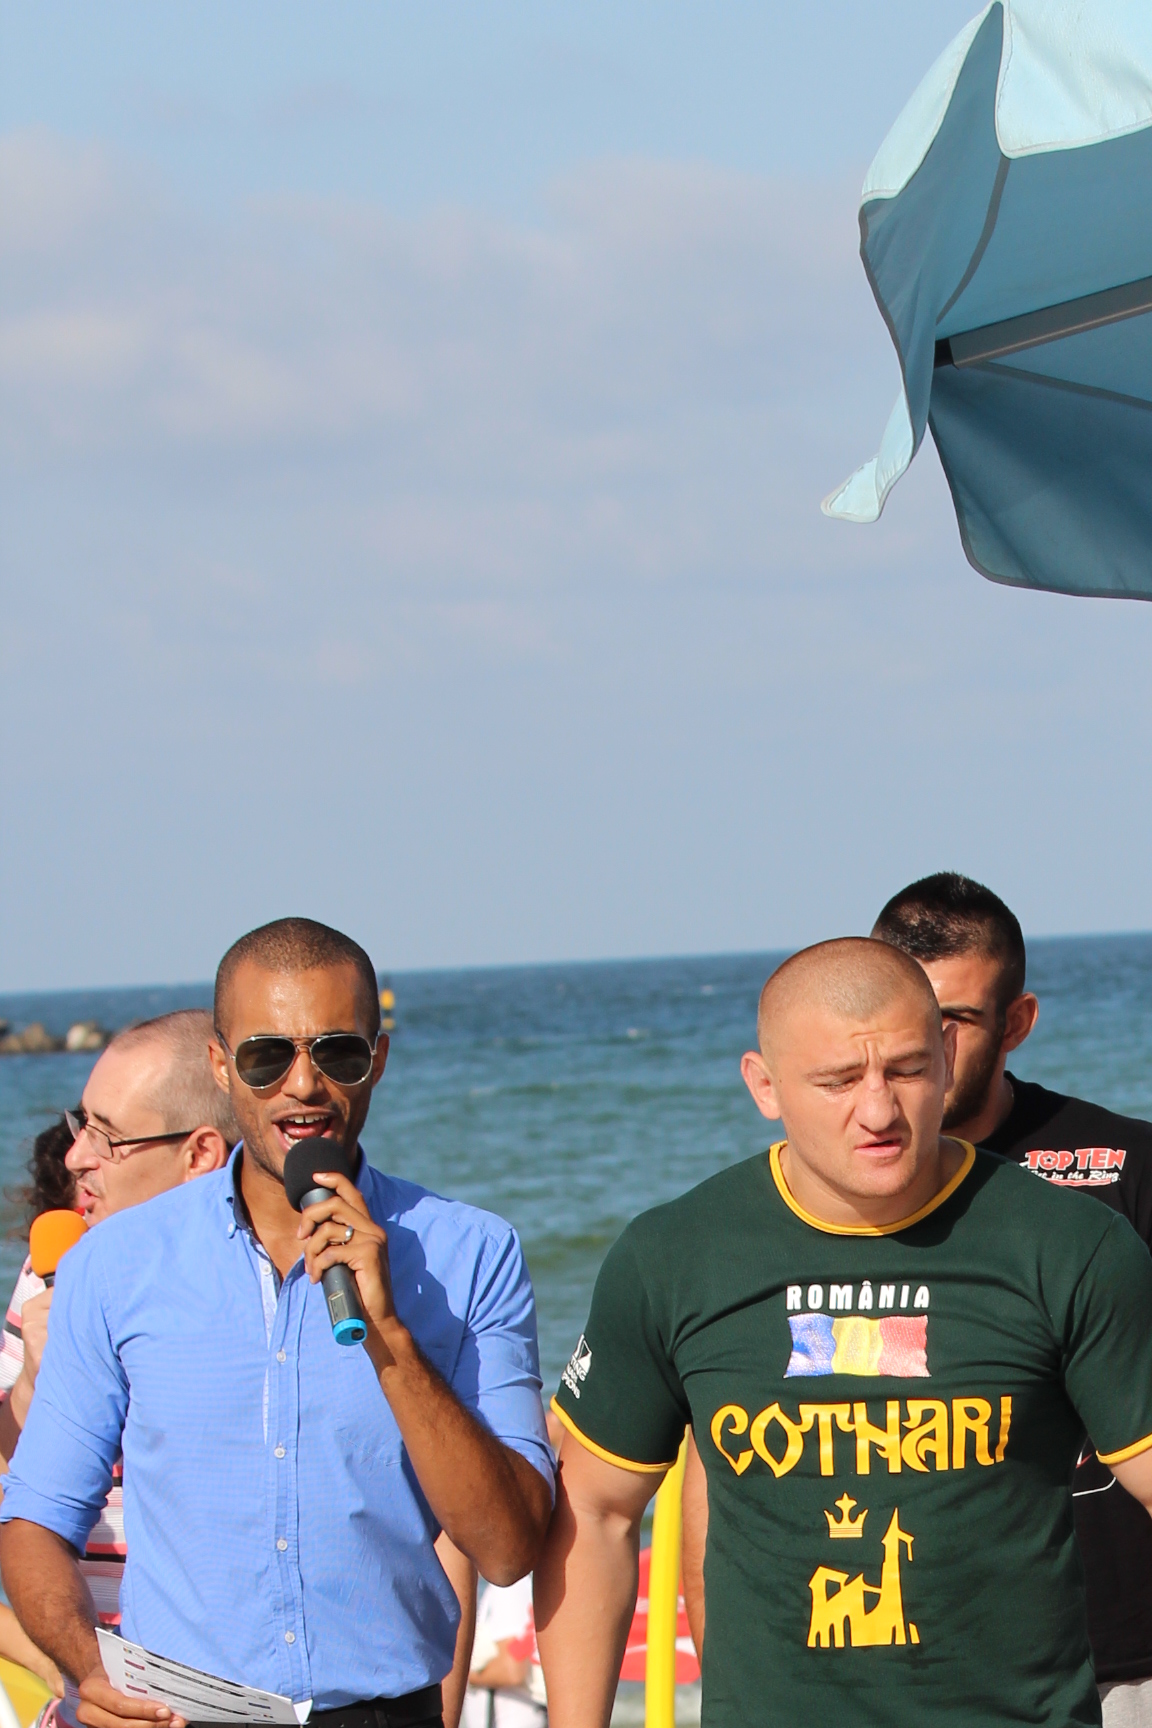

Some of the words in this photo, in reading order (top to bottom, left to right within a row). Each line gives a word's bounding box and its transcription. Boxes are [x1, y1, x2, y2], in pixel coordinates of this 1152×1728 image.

[1025, 1150, 1074, 1170] TOP
[1075, 1148, 1126, 1170] TEN
[786, 1280, 931, 1310] ROMÂNIA
